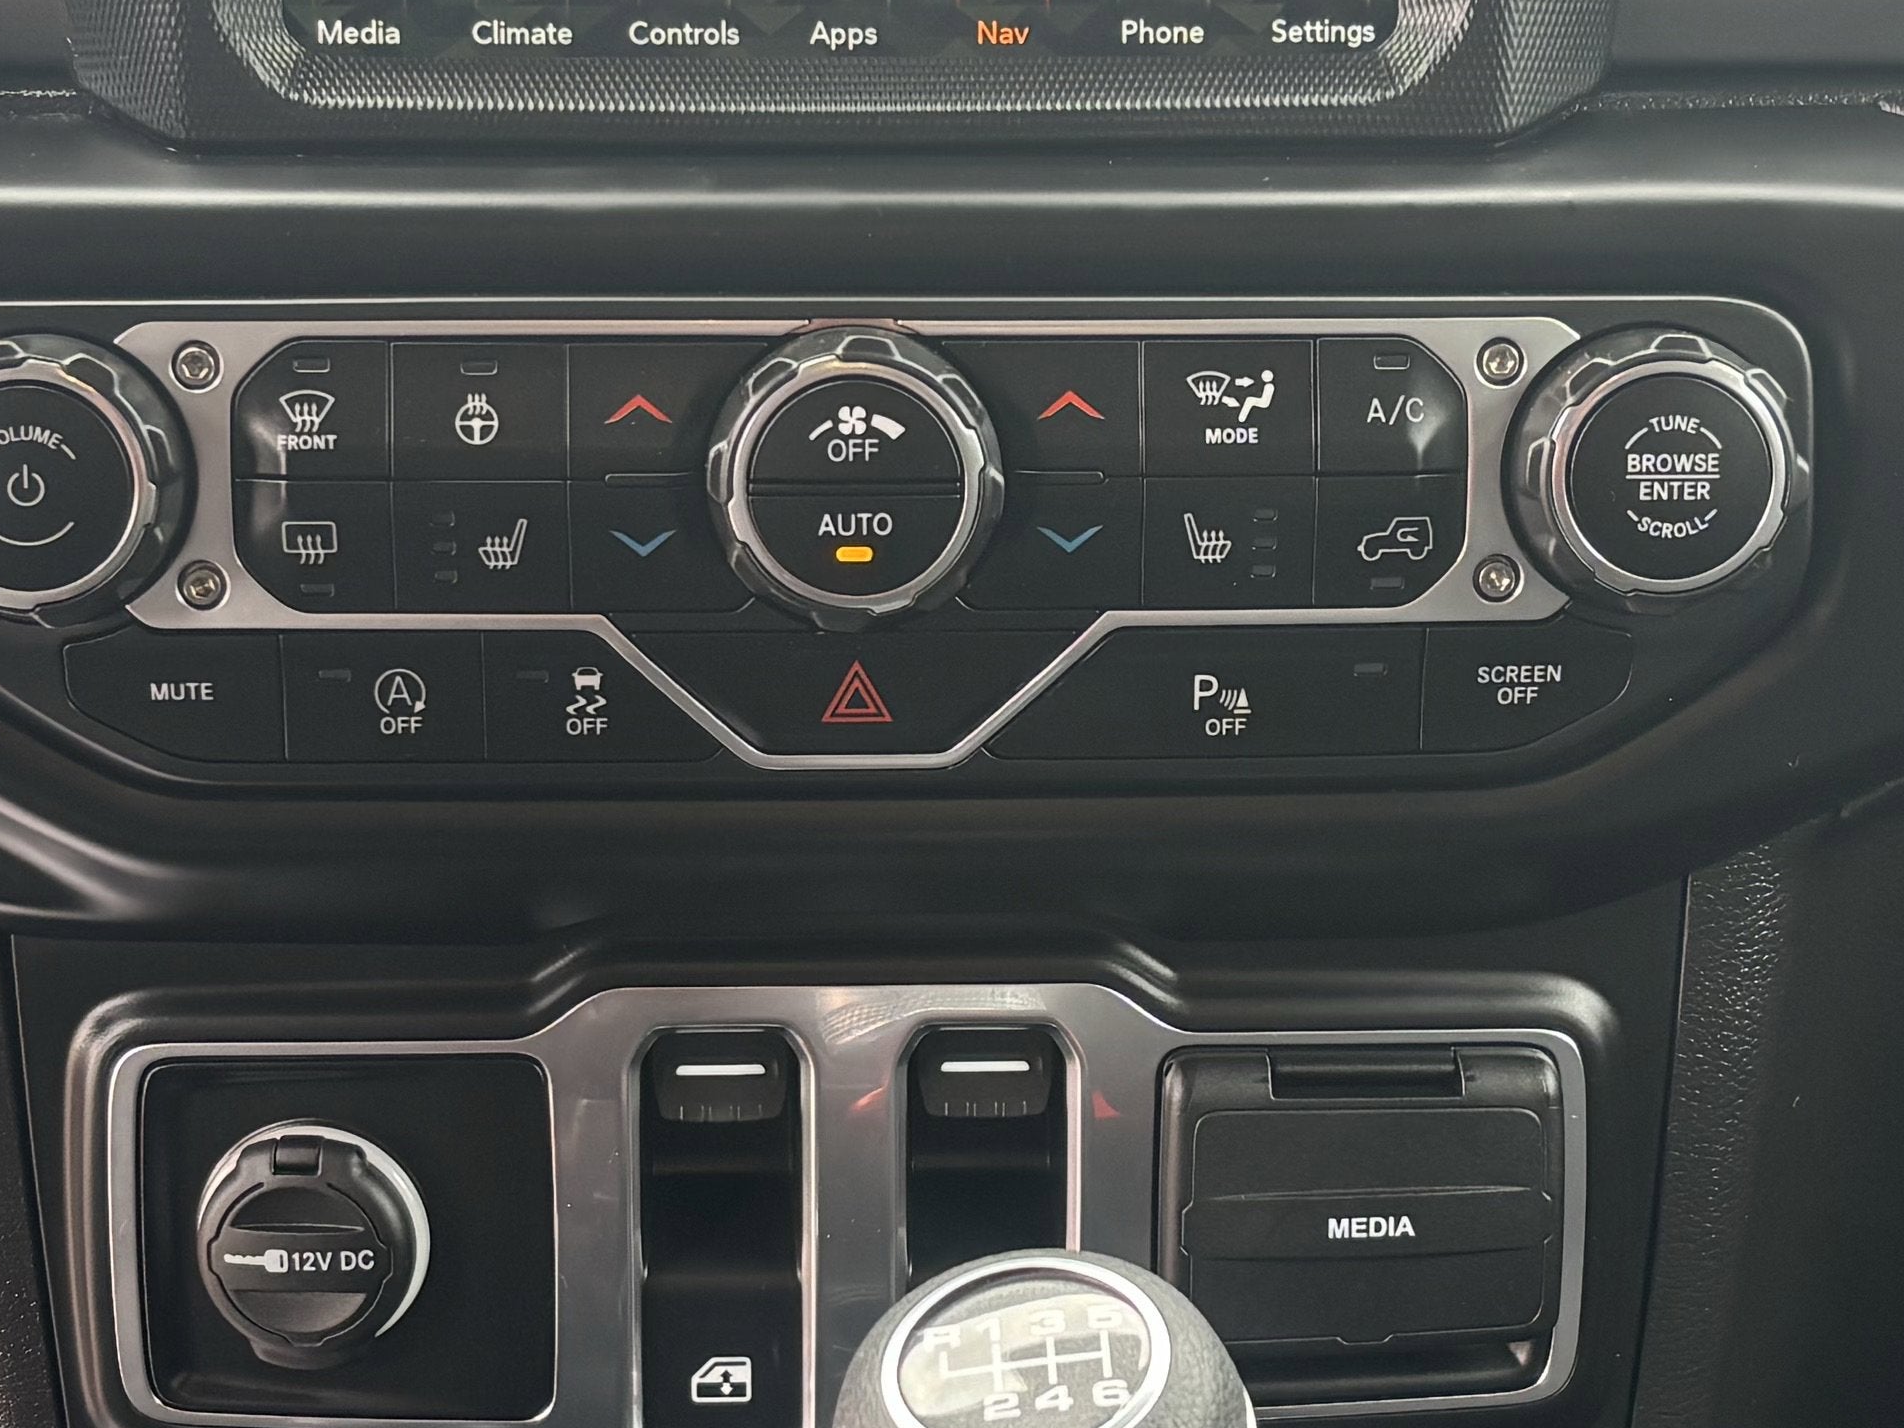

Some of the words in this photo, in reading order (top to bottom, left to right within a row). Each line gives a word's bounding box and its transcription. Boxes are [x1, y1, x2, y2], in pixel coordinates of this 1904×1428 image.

[316, 20, 401, 46] Media
[471, 19, 573, 46] Climate
[628, 19, 741, 47] Controls
[810, 20, 878, 50] Apps
[977, 20, 1030, 47] Nav
[1121, 18, 1205, 46] Phone
[1270, 18, 1376, 48] Settings
[1366, 396, 1425, 426] A/C
[1205, 428, 1259, 445] MODE
[1649, 414, 1701, 435] TUNE
[277, 434, 337, 451] FRONT
[827, 439, 880, 463] OFF
[1626, 452, 1720, 474] BROWSE
[1638, 481, 1711, 502] ENTER
[817, 512, 894, 538] AUTO
[1636, 515, 1710, 539] SCROLL
[1476, 664, 1562, 685] SCREEN
[150, 682, 215, 702] MUTE
[1496, 687, 1539, 706] OFF
[379, 716, 424, 736] OFF
[565, 717, 609, 736] OFF
[1205, 718, 1248, 737] OFF
[1327, 1216, 1416, 1240] MEDIA
[290, 1250, 333, 1273] 12V
[340, 1249, 376, 1272] DC
[975, 1317, 1001, 1342] 1
[1030, 1309, 1066, 1336] 3
[1087, 1304, 1123, 1330] 5
[983, 1391, 1022, 1422] 2
[1035, 1384, 1074, 1412] 4
[1092, 1378, 1130, 1407] 6
